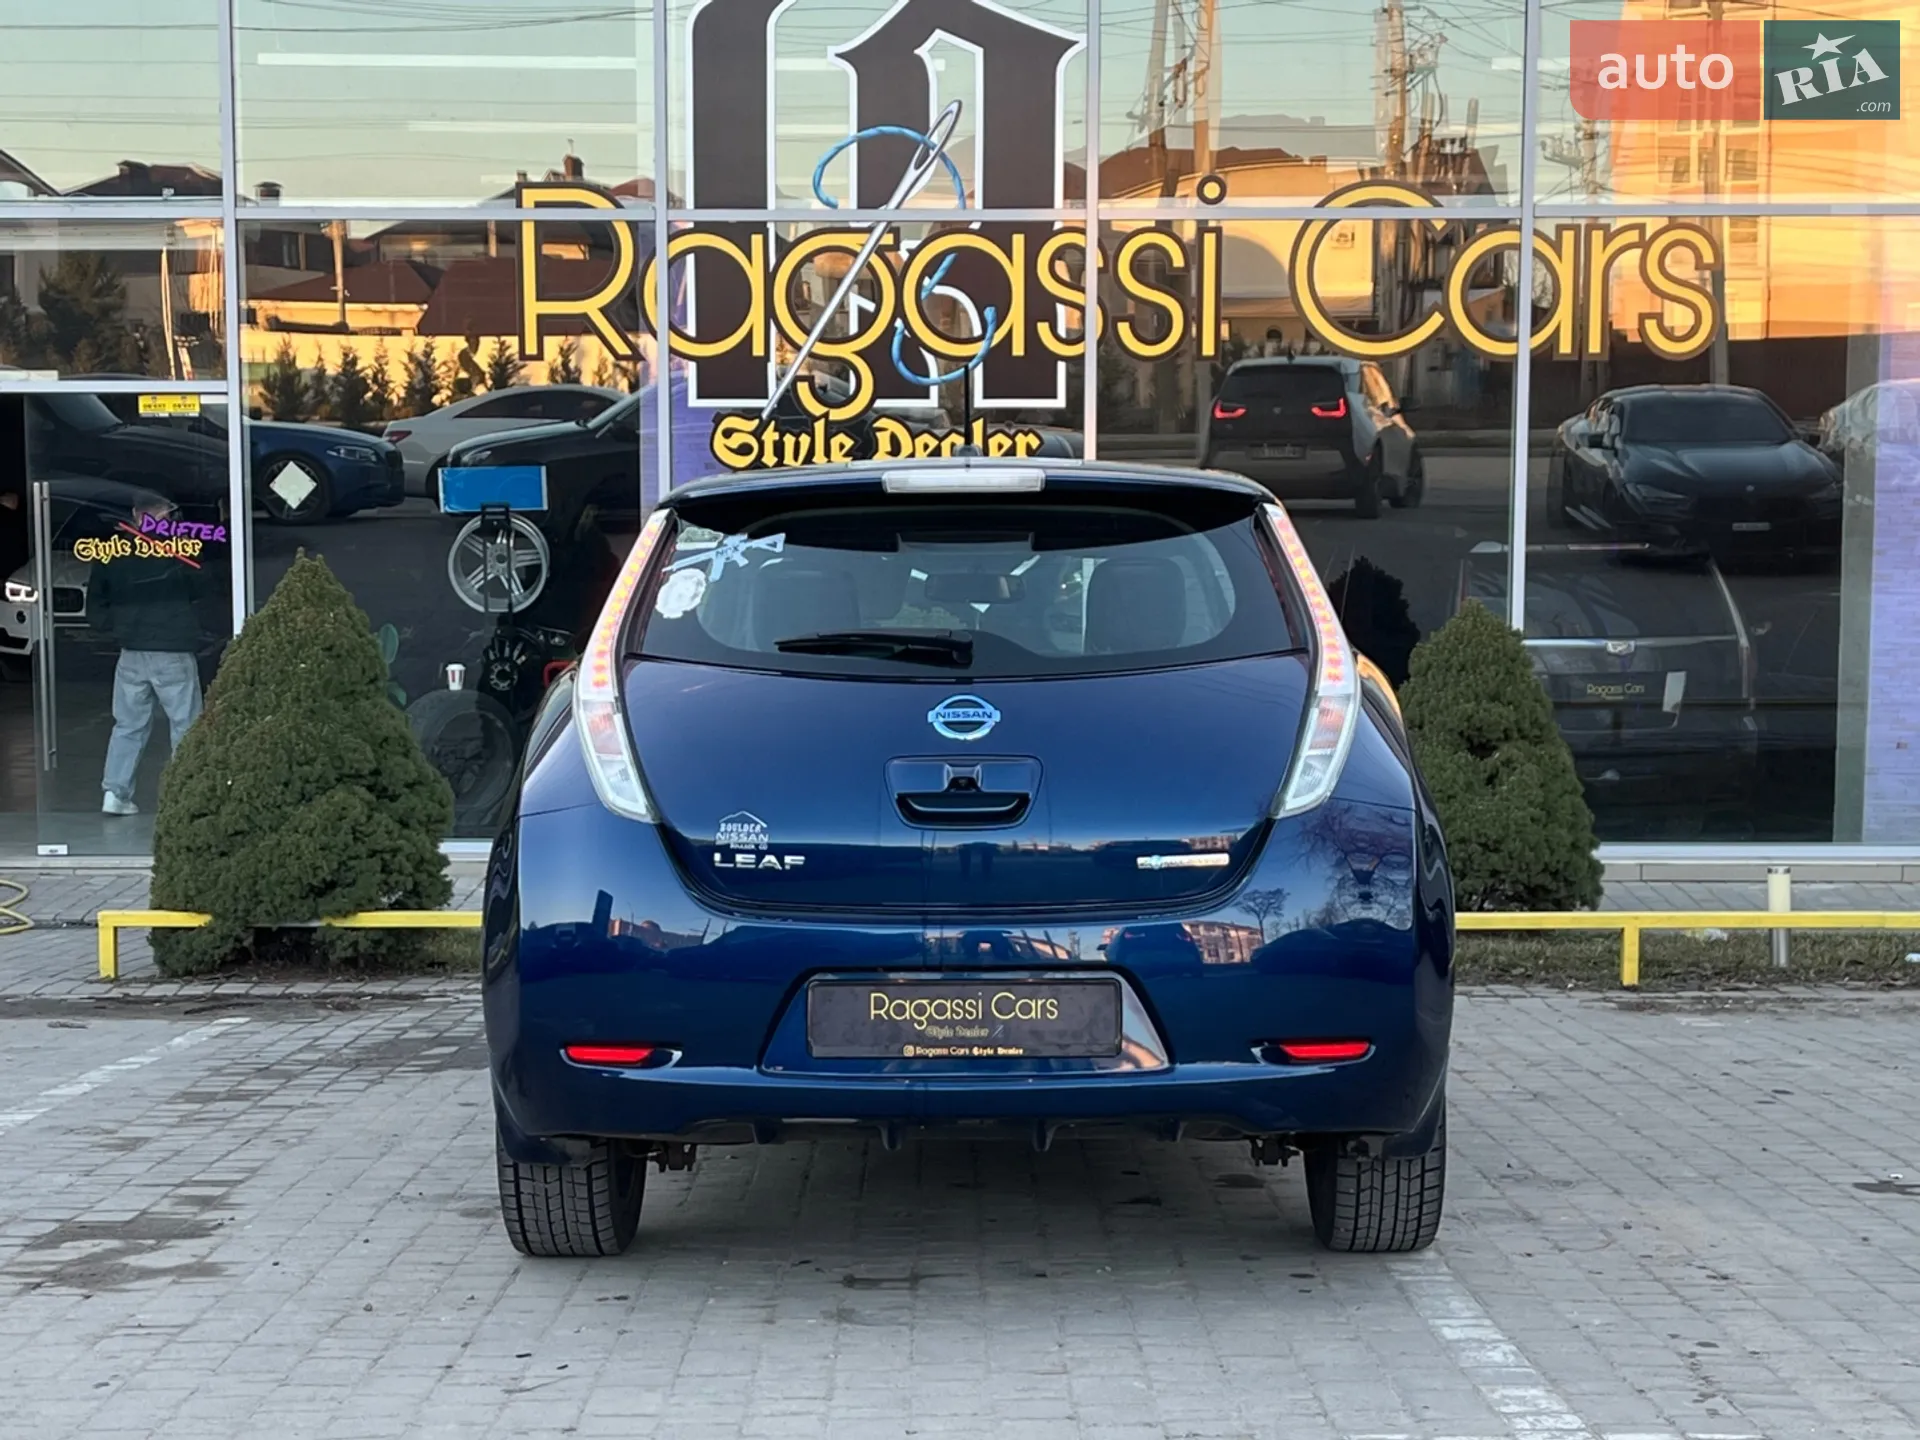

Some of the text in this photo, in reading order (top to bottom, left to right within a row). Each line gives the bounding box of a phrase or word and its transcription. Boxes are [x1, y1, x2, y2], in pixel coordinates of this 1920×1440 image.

[519, 181, 1720, 416] Ragassi Cars
[712, 413, 856, 470] Style
[140, 512, 227, 542] DRIFTER
[74, 534, 203, 564] Style Dealer
[935, 710, 993, 719] NISSAN
[715, 831, 769, 843] NISSAN
[713, 852, 806, 870] LEAF
[870, 991, 1059, 1029] Ragassi Cars
